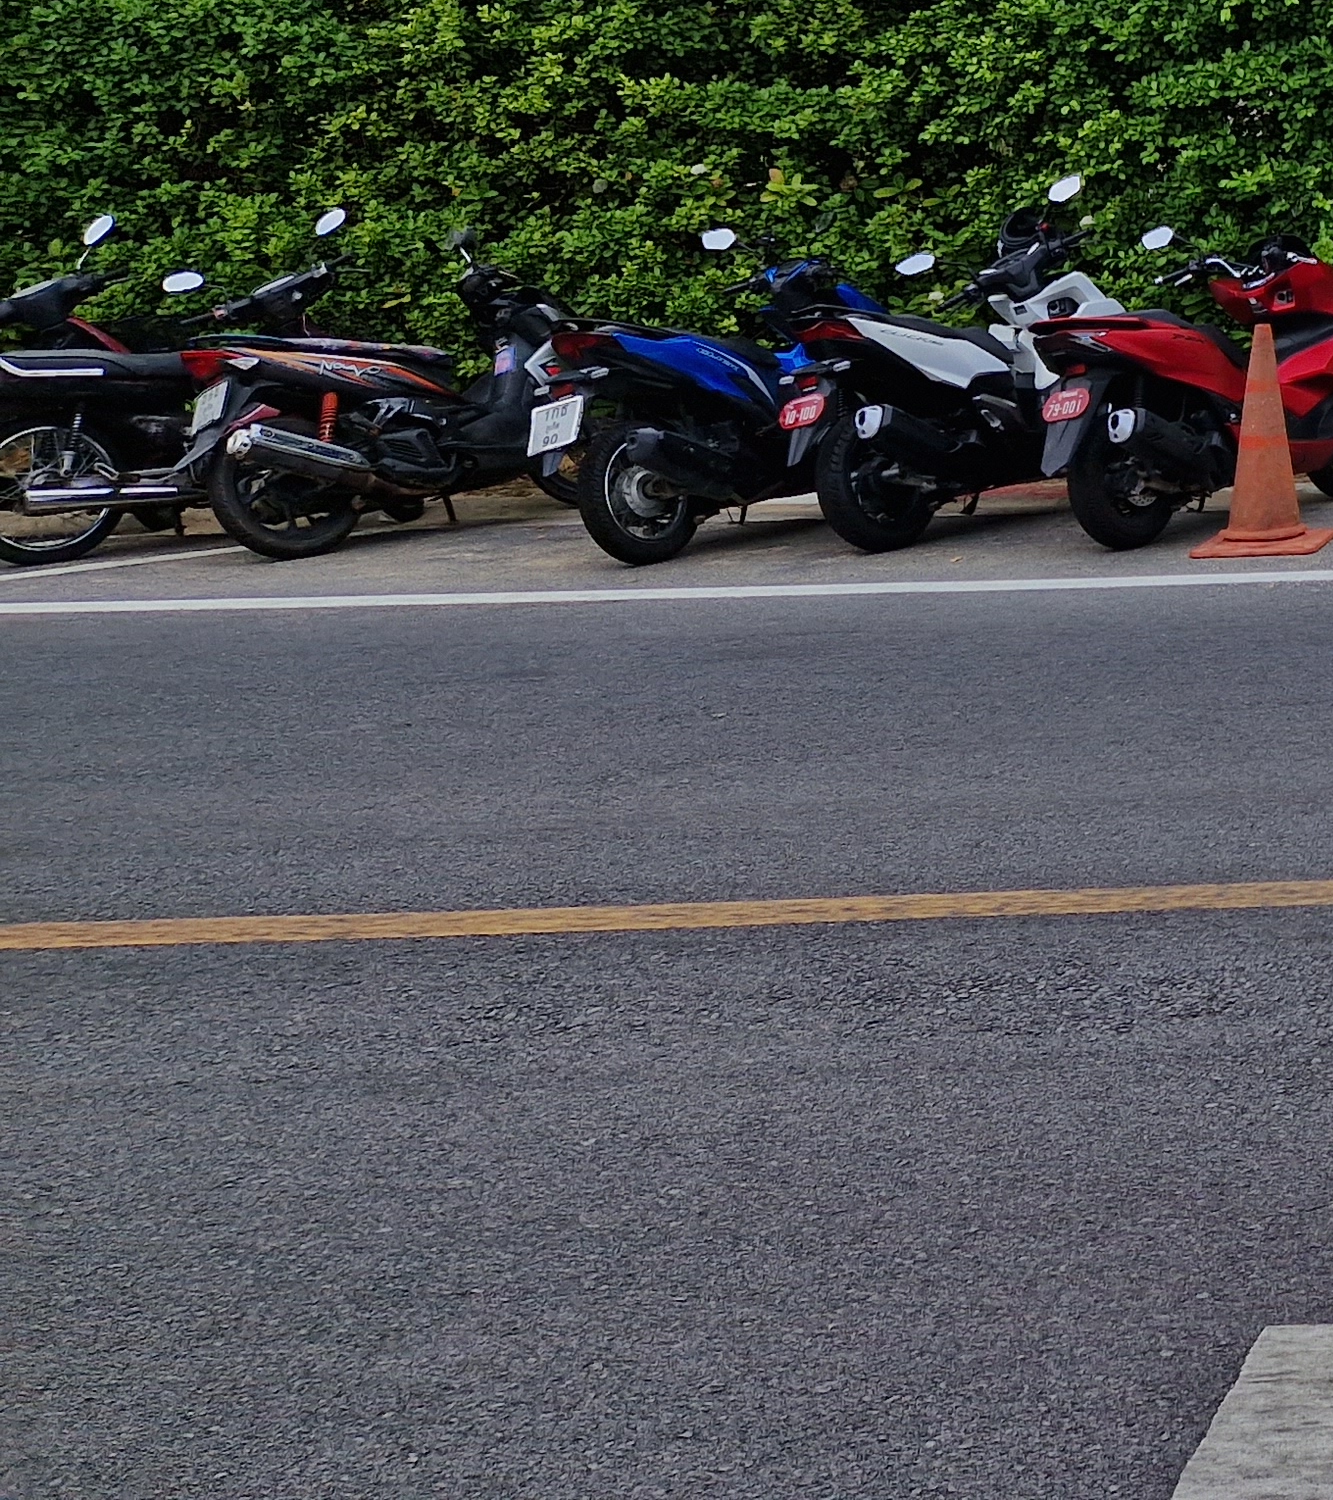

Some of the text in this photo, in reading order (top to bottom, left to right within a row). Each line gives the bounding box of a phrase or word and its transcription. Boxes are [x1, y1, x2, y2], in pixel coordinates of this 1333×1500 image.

[784, 405, 817, 426] 10-100
[1046, 398, 1083, 418] 79-001
[542, 433, 559, 448] 90
